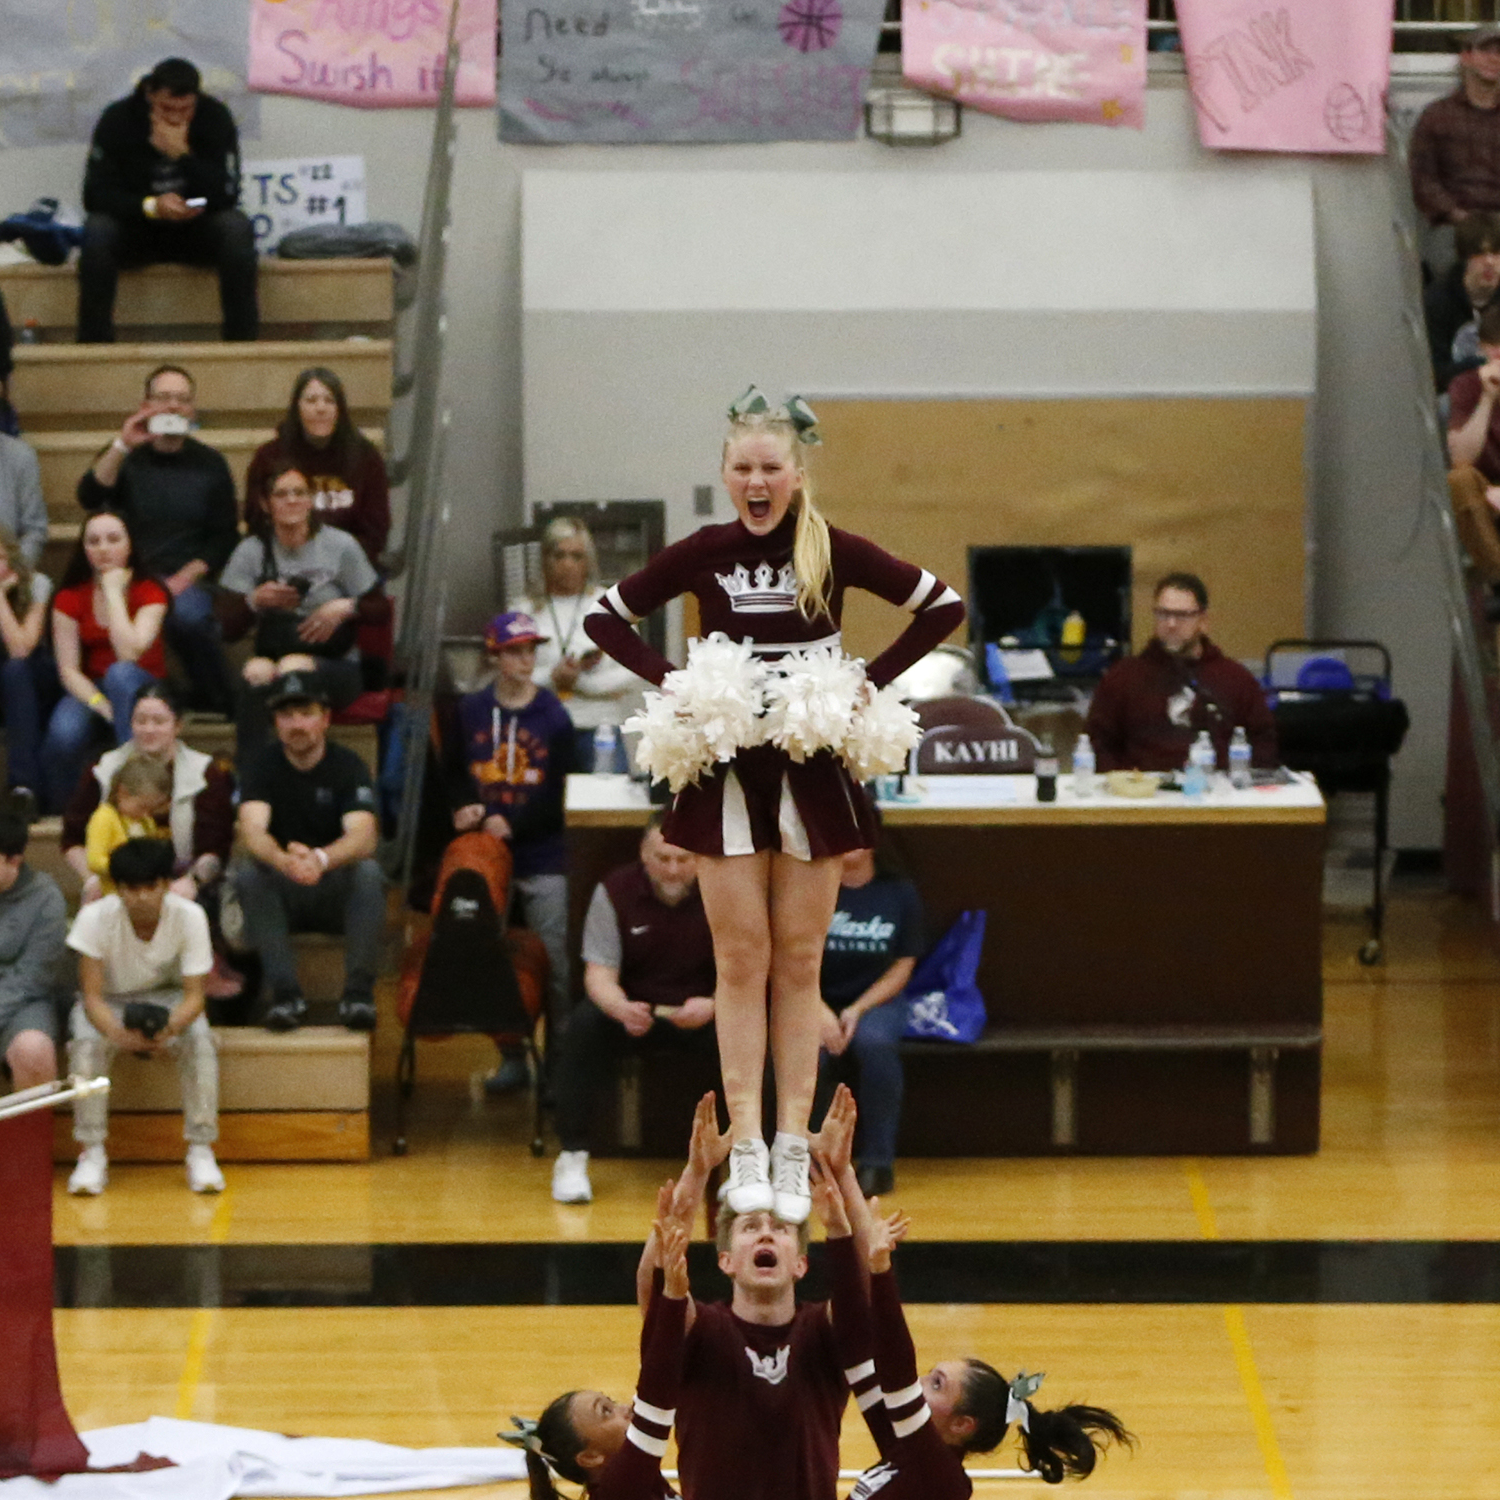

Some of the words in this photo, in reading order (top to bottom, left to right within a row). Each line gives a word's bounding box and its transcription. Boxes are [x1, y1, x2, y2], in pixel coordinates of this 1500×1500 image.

[277, 30, 393, 91] Swish
[240, 174, 298, 205] TS
[934, 739, 1018, 763] KAYHI
[828, 911, 895, 940] laska
